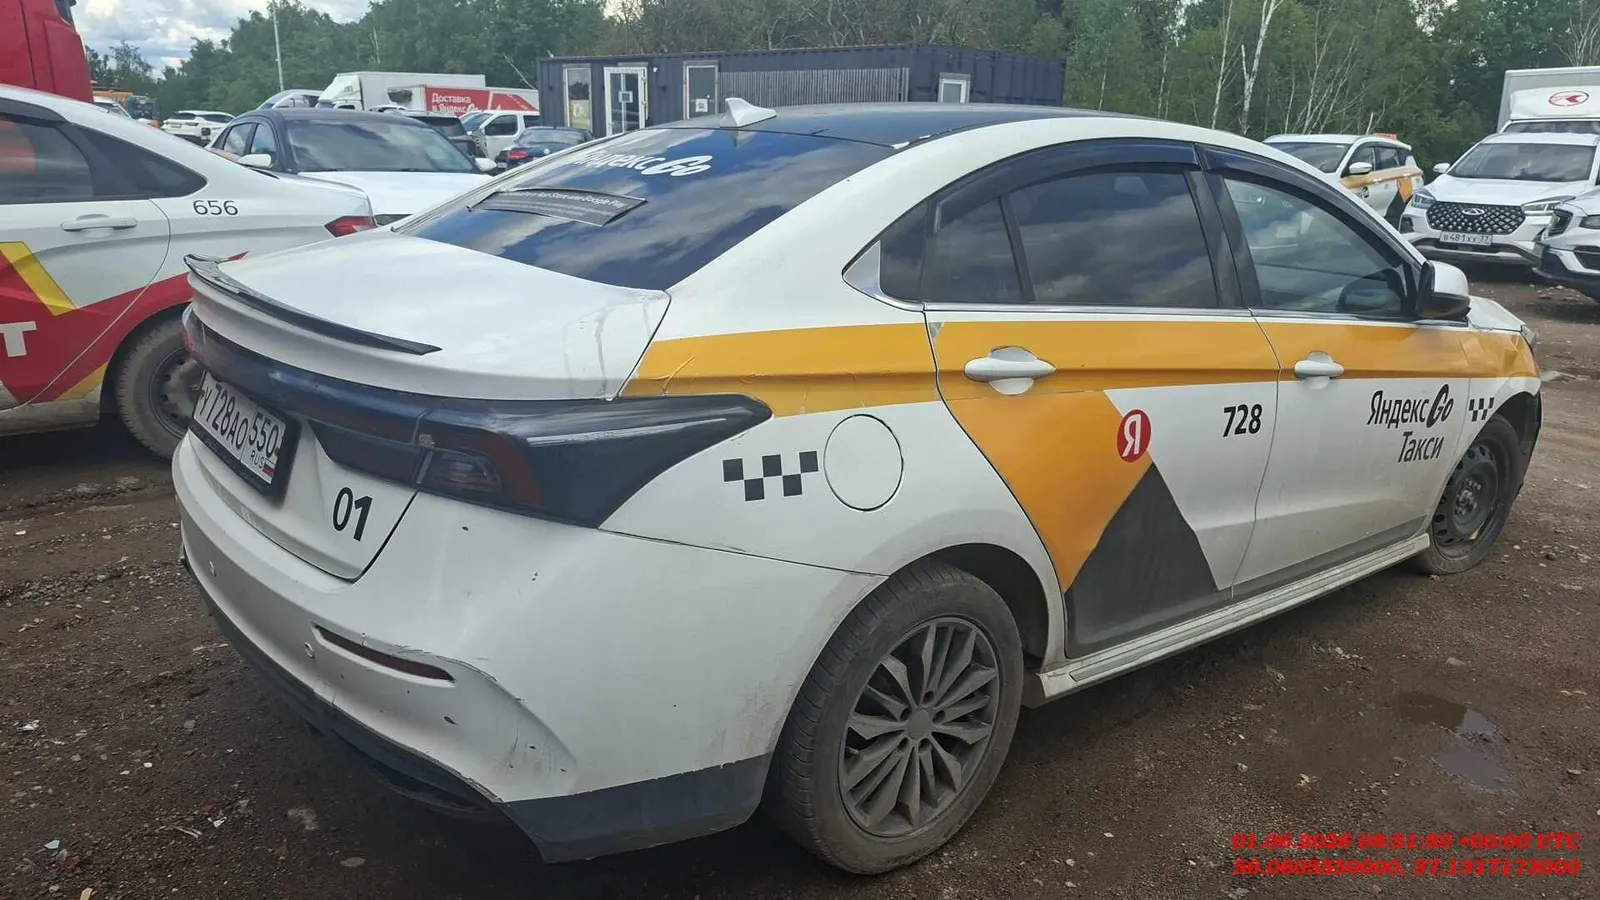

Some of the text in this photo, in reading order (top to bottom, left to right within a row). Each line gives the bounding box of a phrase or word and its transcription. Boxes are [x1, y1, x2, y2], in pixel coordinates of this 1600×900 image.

[432, 93, 471, 104] Доставка
[439, 103, 467, 113] Яндекс
[641, 155, 713, 177] Go
[193, 200, 239, 216] 656
[1222, 403, 1263, 438] 728
[1366, 384, 1454, 429] Яндекс Go
[248, 411, 279, 458] 550
[1121, 413, 1142, 457] Я
[1398, 430, 1445, 463] Такси
[251, 450, 265, 469] RUS
[333, 486, 373, 541] 01
